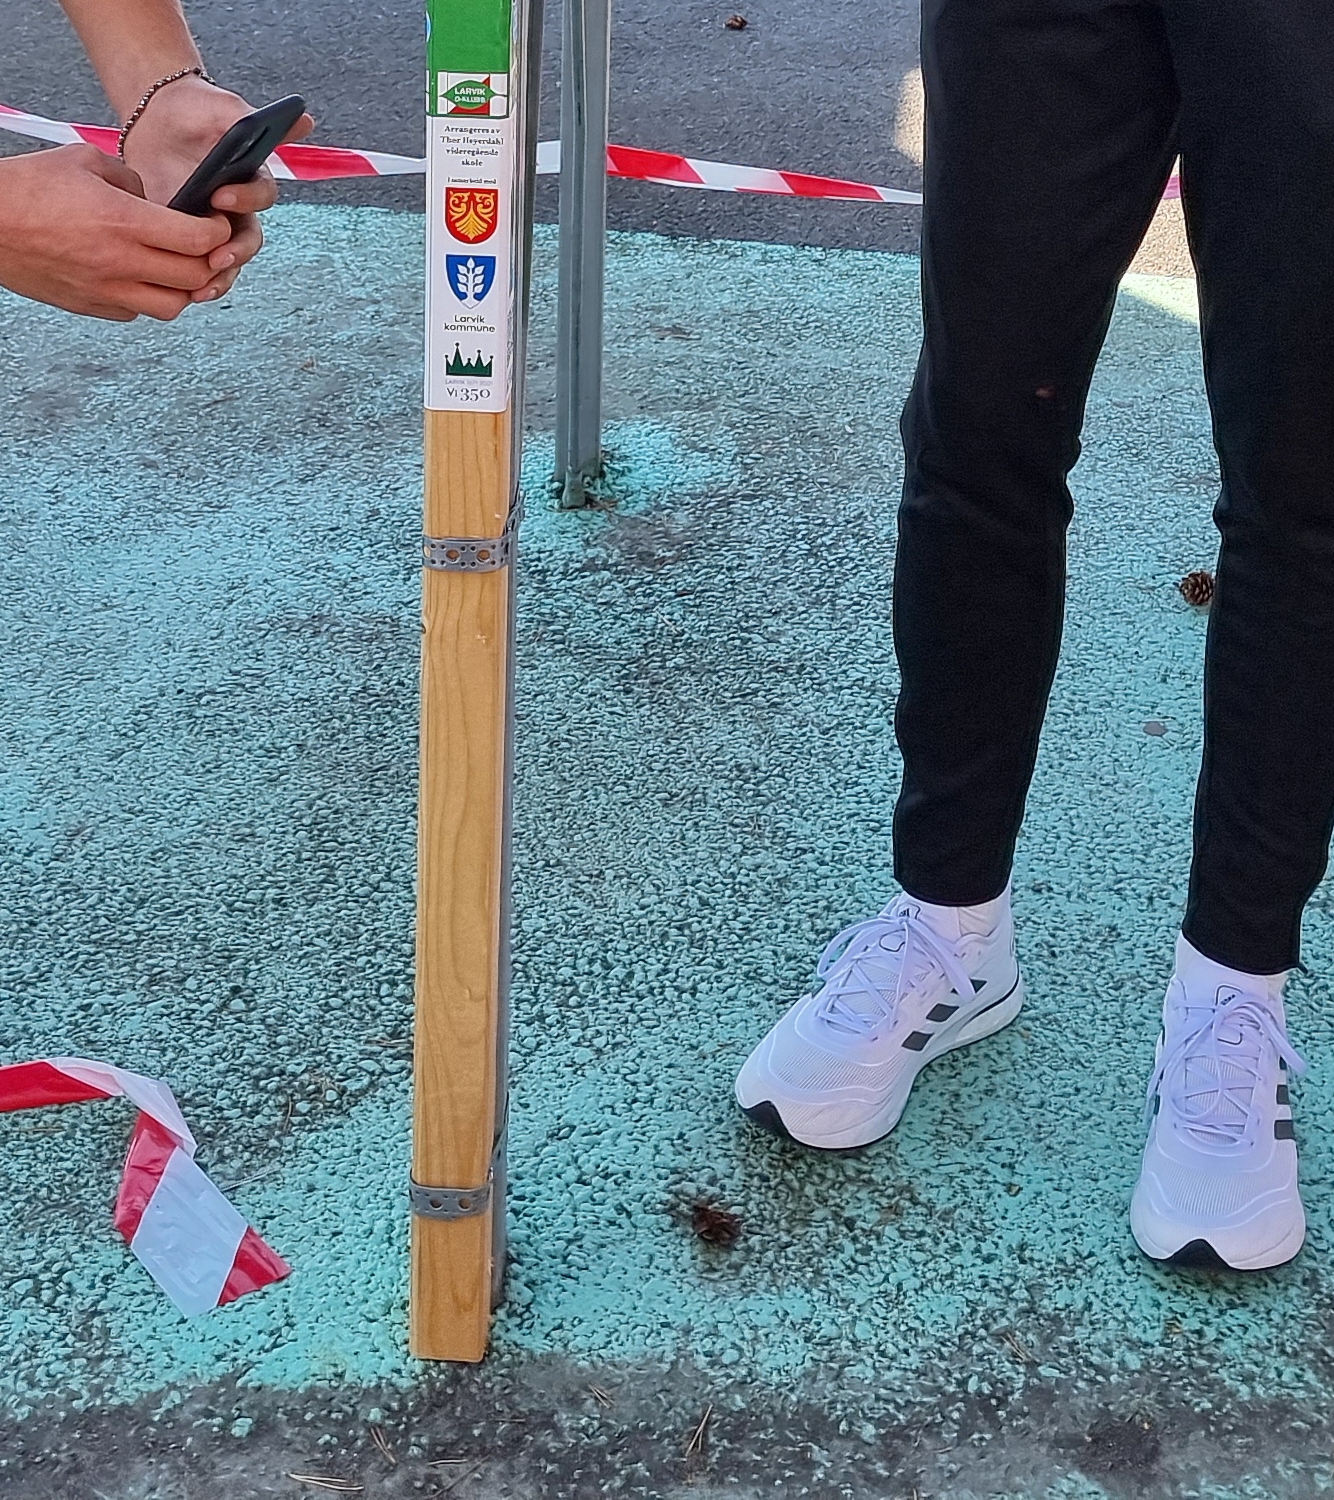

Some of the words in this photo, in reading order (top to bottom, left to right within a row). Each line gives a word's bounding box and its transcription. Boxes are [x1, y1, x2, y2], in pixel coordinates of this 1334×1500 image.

[454, 87, 486, 95] LARVIK
[461, 158, 484, 166] skole
[454, 314, 485, 323] Larvik
[443, 322, 496, 333] kommune
[460, 387, 491, 402] 350
